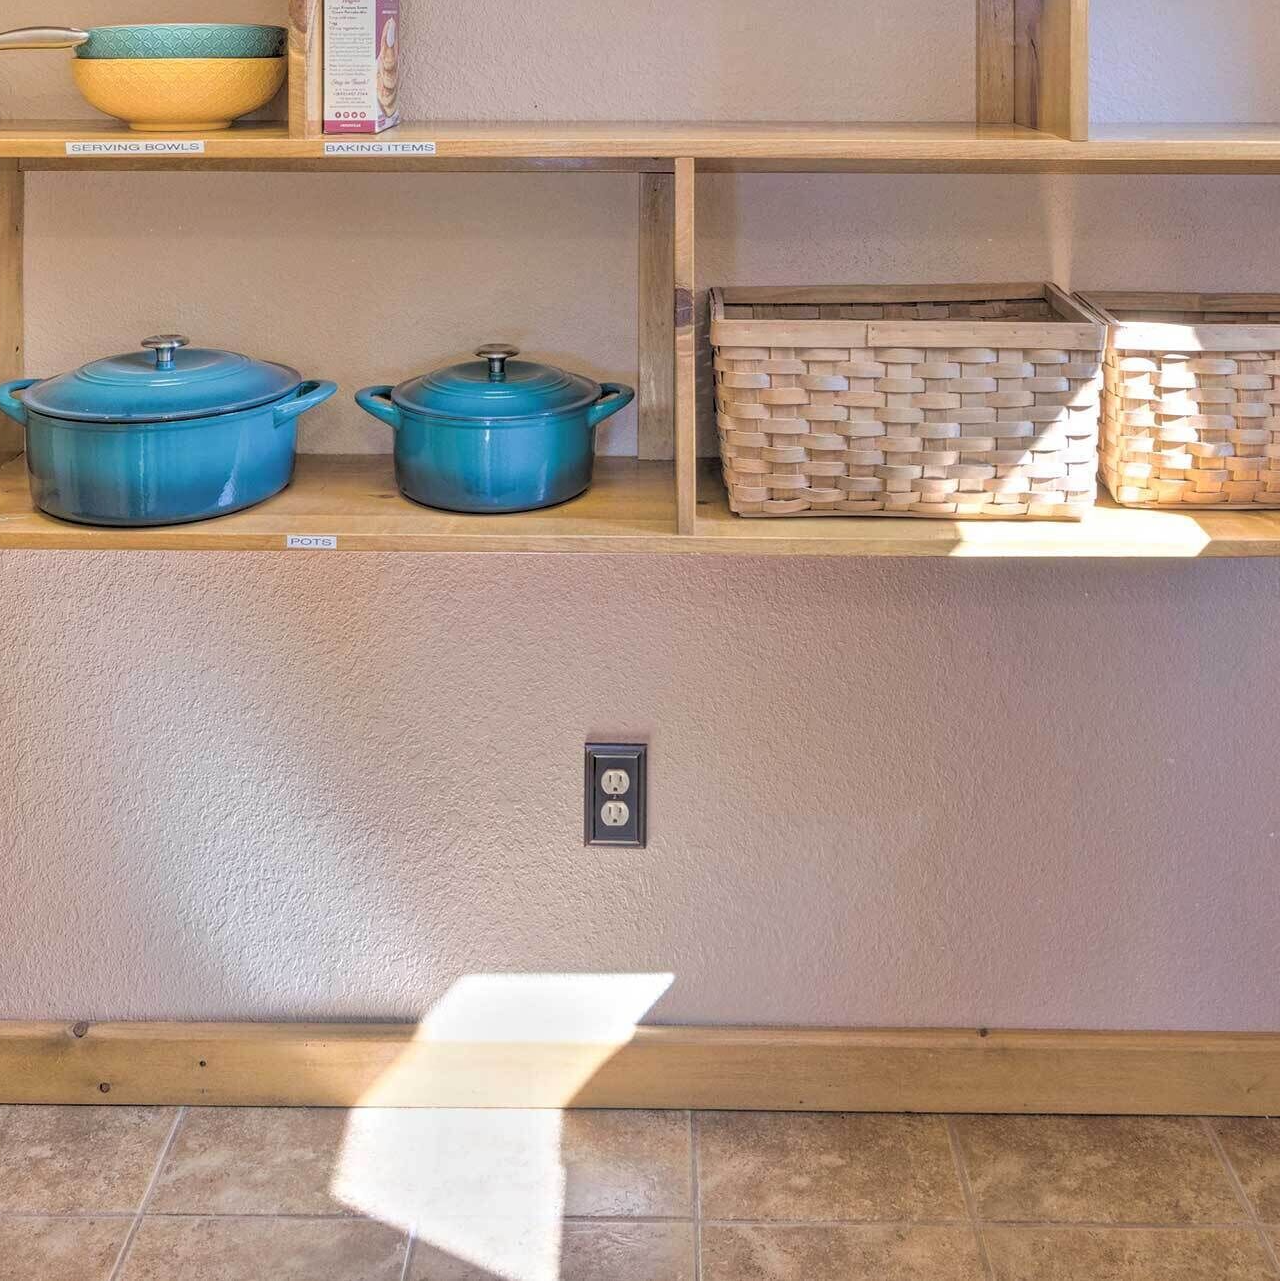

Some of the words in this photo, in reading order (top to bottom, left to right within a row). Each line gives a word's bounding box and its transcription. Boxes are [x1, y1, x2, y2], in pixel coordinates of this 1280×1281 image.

[71, 144, 139, 152] SERVING
[145, 143, 200, 151] BOWLS
[326, 144, 383, 152] BAKING
[388, 144, 434, 152] ITEMS
[290, 538, 332, 546] POTS
